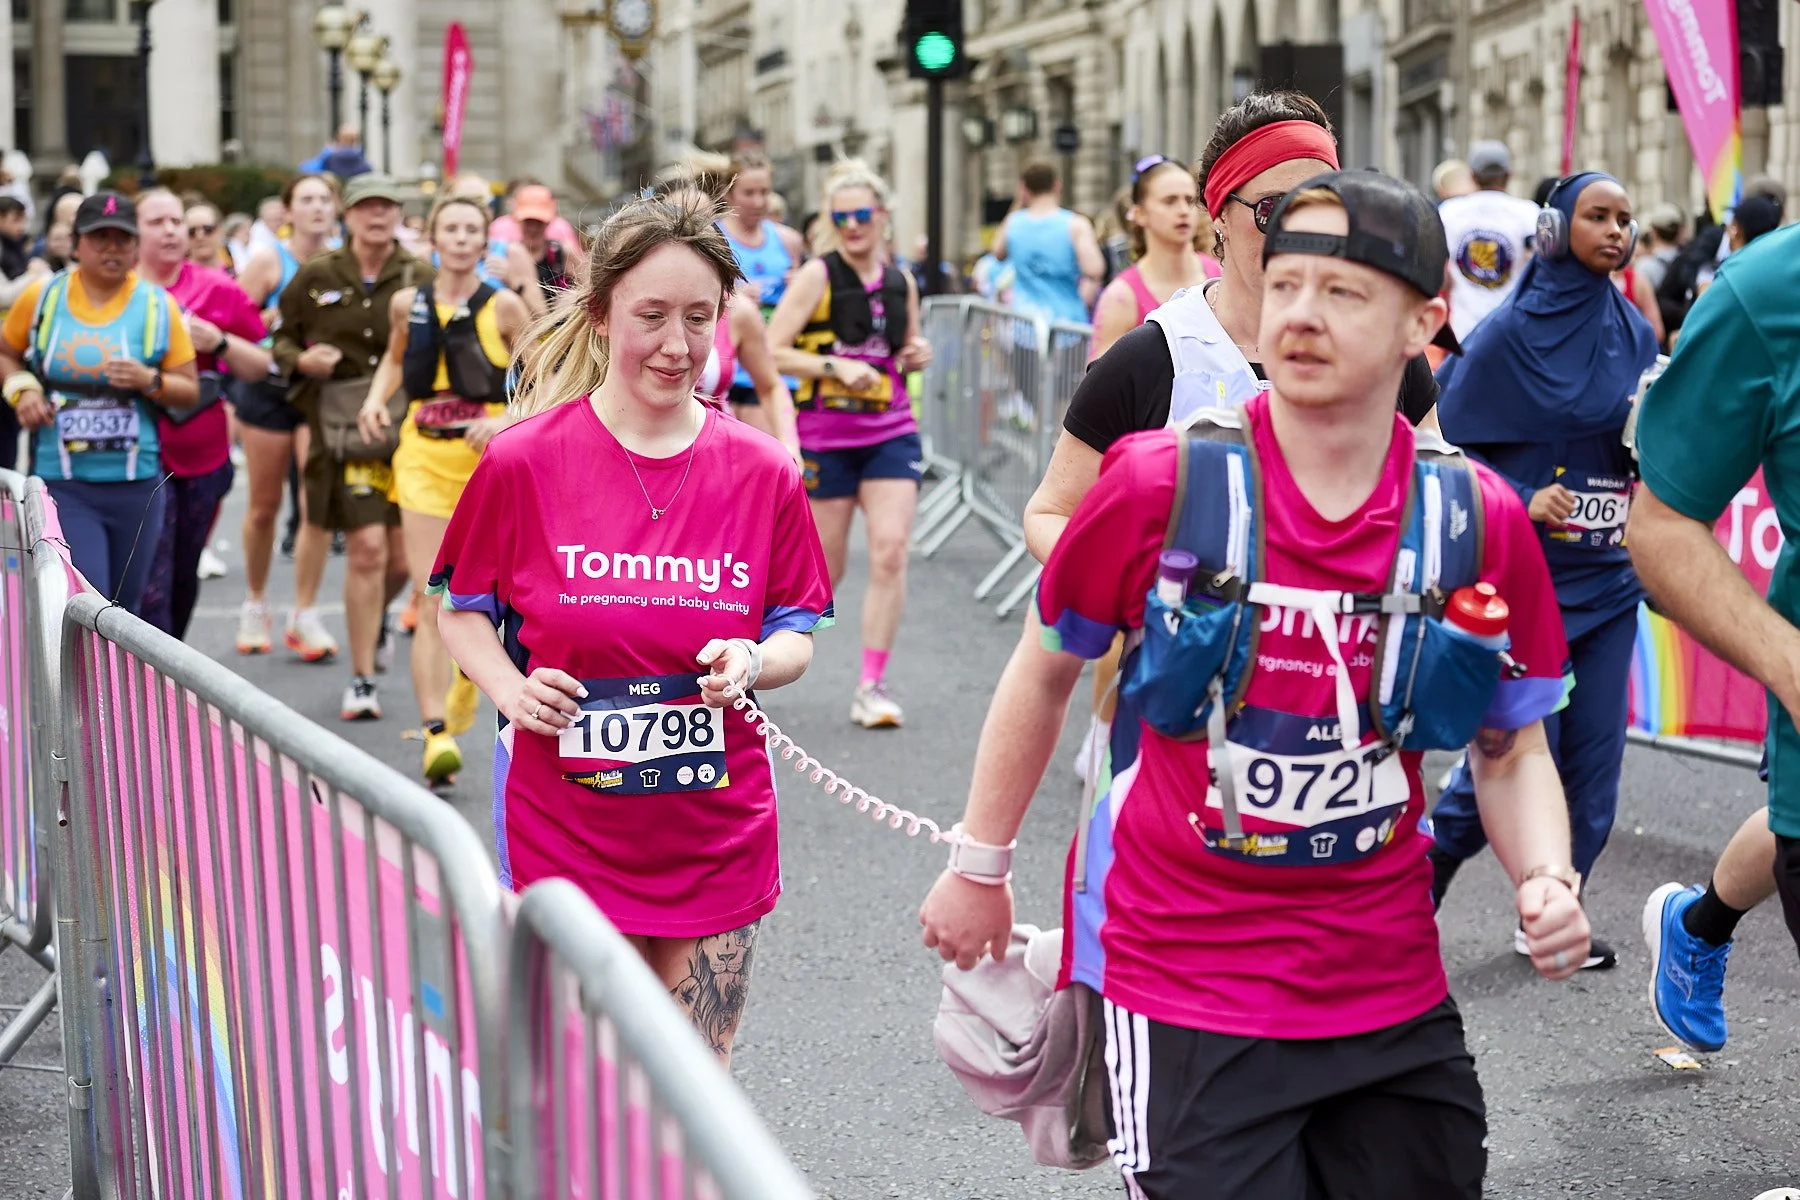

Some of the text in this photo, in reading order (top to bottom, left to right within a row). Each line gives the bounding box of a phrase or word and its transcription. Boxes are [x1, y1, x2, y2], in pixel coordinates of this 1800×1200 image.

[63, 412, 133, 434] 20537
[556, 544, 750, 594] Tommy's
[558, 593, 750, 615] The pregnancy and baby charity
[628, 682, 661, 696] MEG
[574, 707, 715, 753] 10798
[1305, 724, 1342, 742] ALE
[703, 772, 710, 780] 4
